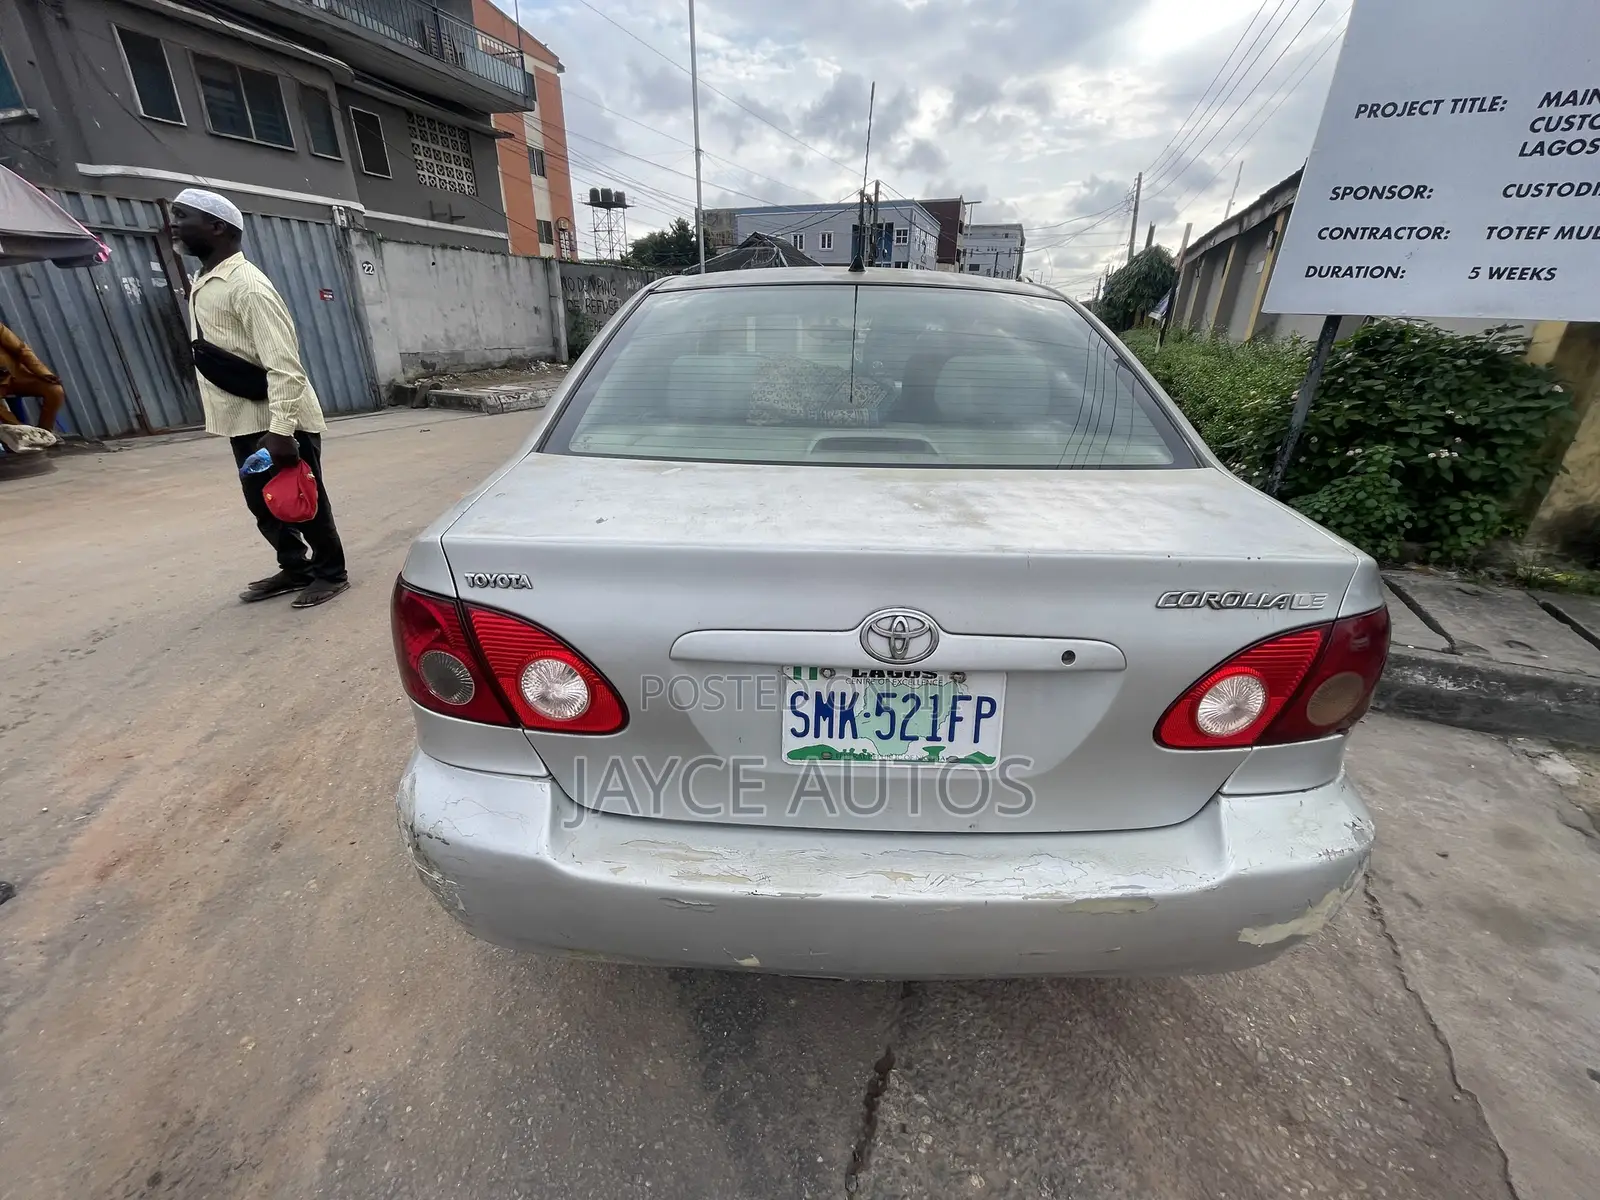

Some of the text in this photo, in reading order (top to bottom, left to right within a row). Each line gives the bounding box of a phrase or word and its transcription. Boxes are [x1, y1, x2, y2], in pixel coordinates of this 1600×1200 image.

[1354, 96, 1508, 119] PROJECT TITLE:
[1518, 138, 1600, 157] LAGOS
[1329, 184, 1434, 201] SPONSOR:
[1502, 182, 1600, 198] CUSTODI
[1317, 226, 1451, 240] CONTRACTOR:
[1486, 226, 1551, 240] TOTEF
[362, 263, 375, 275] 22
[1304, 265, 1406, 279] DURATION:
[1468, 266, 1558, 281] 5 WEEKS
[464, 572, 533, 589] TOYOTA
[1156, 591, 1329, 611] COROLLA LE
